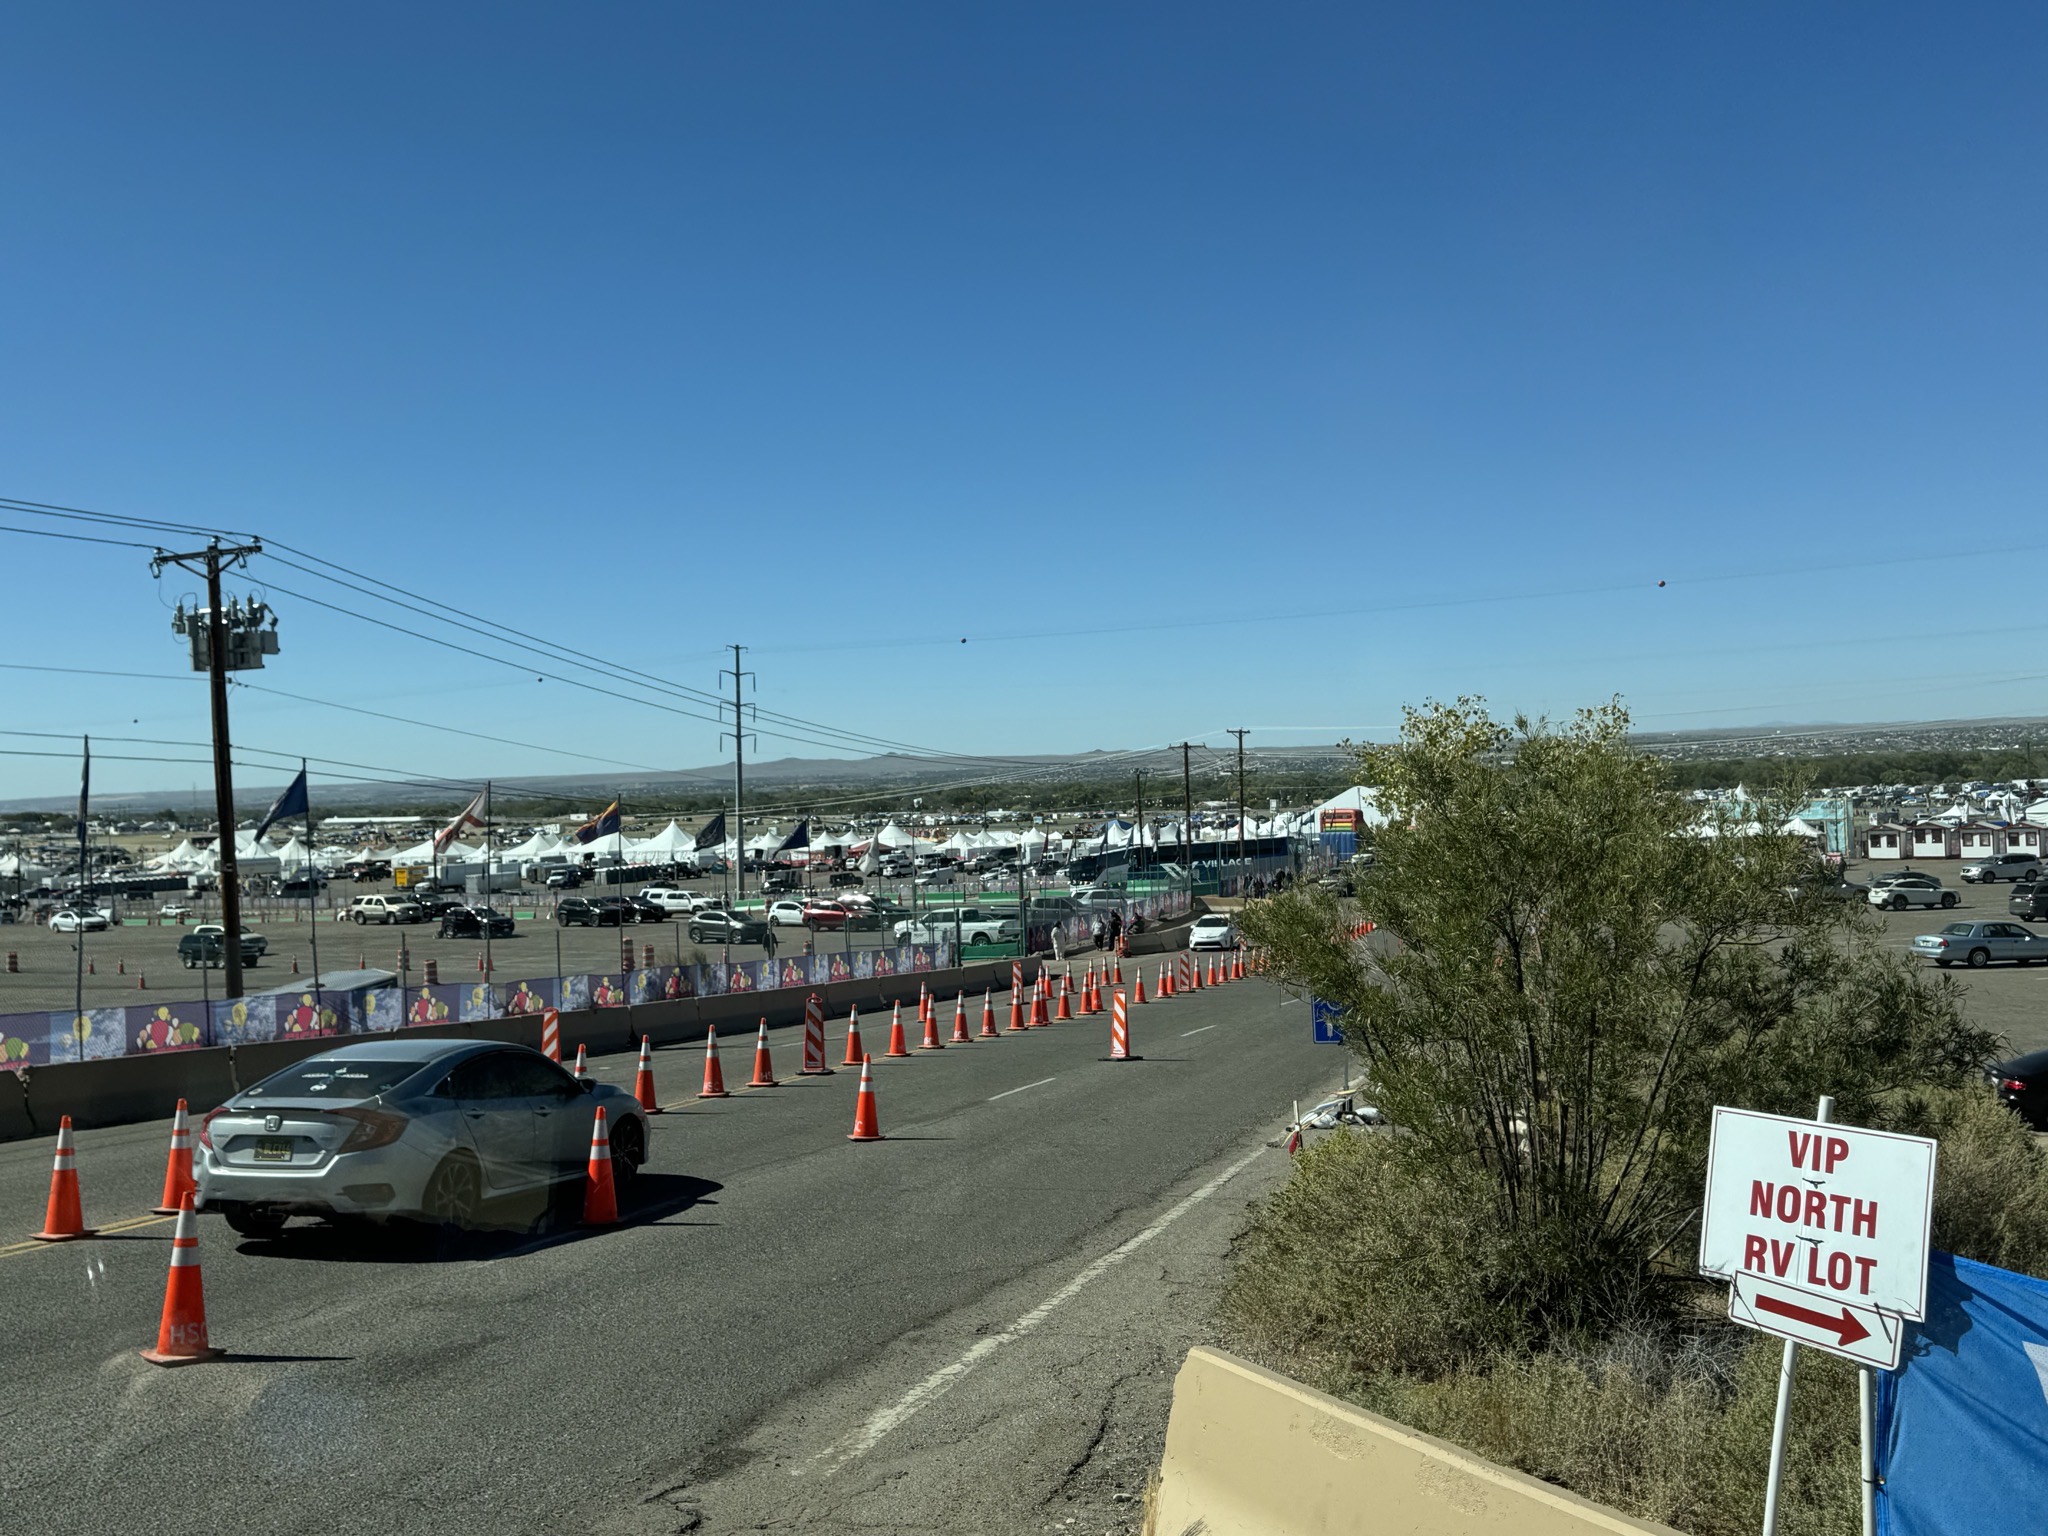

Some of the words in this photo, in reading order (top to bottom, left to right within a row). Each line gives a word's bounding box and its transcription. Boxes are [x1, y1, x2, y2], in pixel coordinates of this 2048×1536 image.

[1788, 1130, 1850, 1174] VIP
[1749, 1179, 1878, 1239] NORTH
[1744, 1234, 1795, 1278] RV
[1807, 1247, 1878, 1295] LOT
